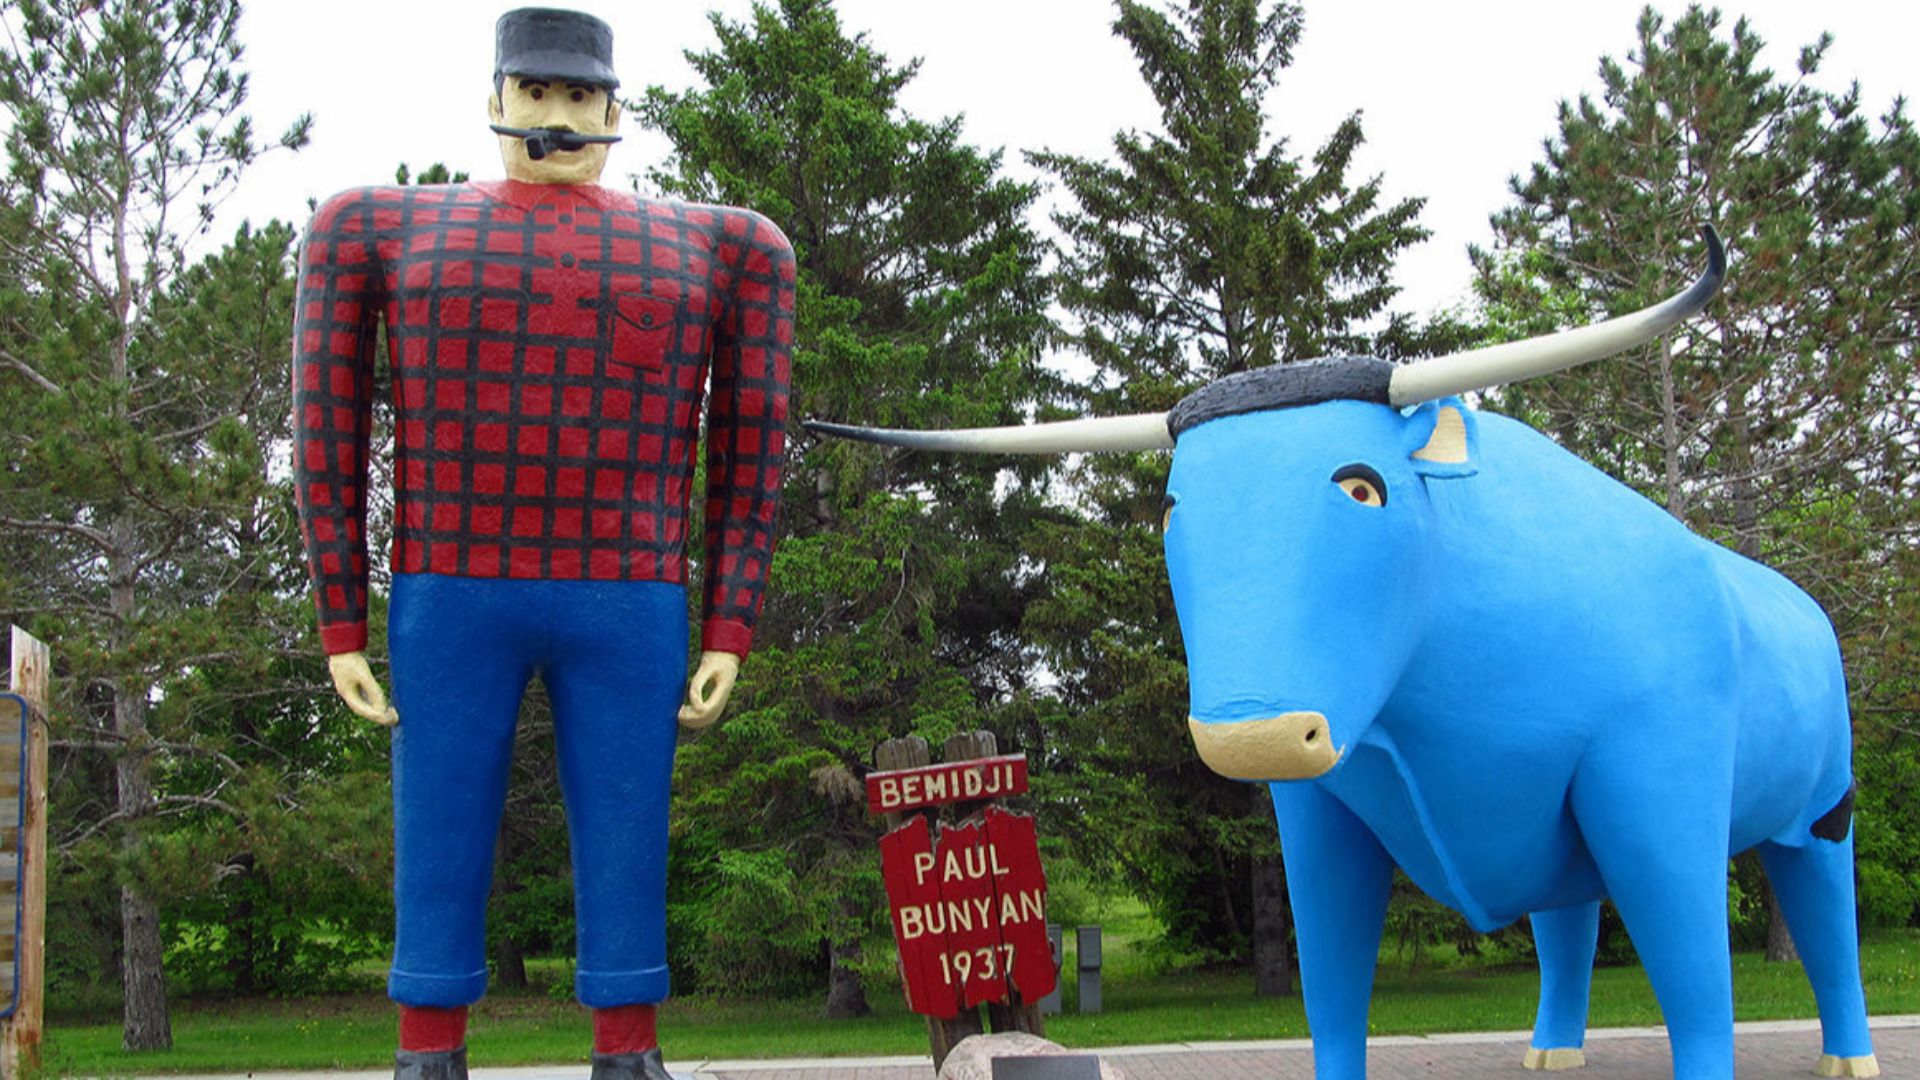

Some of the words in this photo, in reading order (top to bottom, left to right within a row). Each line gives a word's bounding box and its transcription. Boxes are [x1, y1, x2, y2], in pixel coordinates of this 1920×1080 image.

[880, 765, 1013, 807] BEMIDJI
[914, 844, 1009, 885] PAUL
[900, 889, 1043, 939] BUNYAN
[940, 944, 1015, 985] 1937
